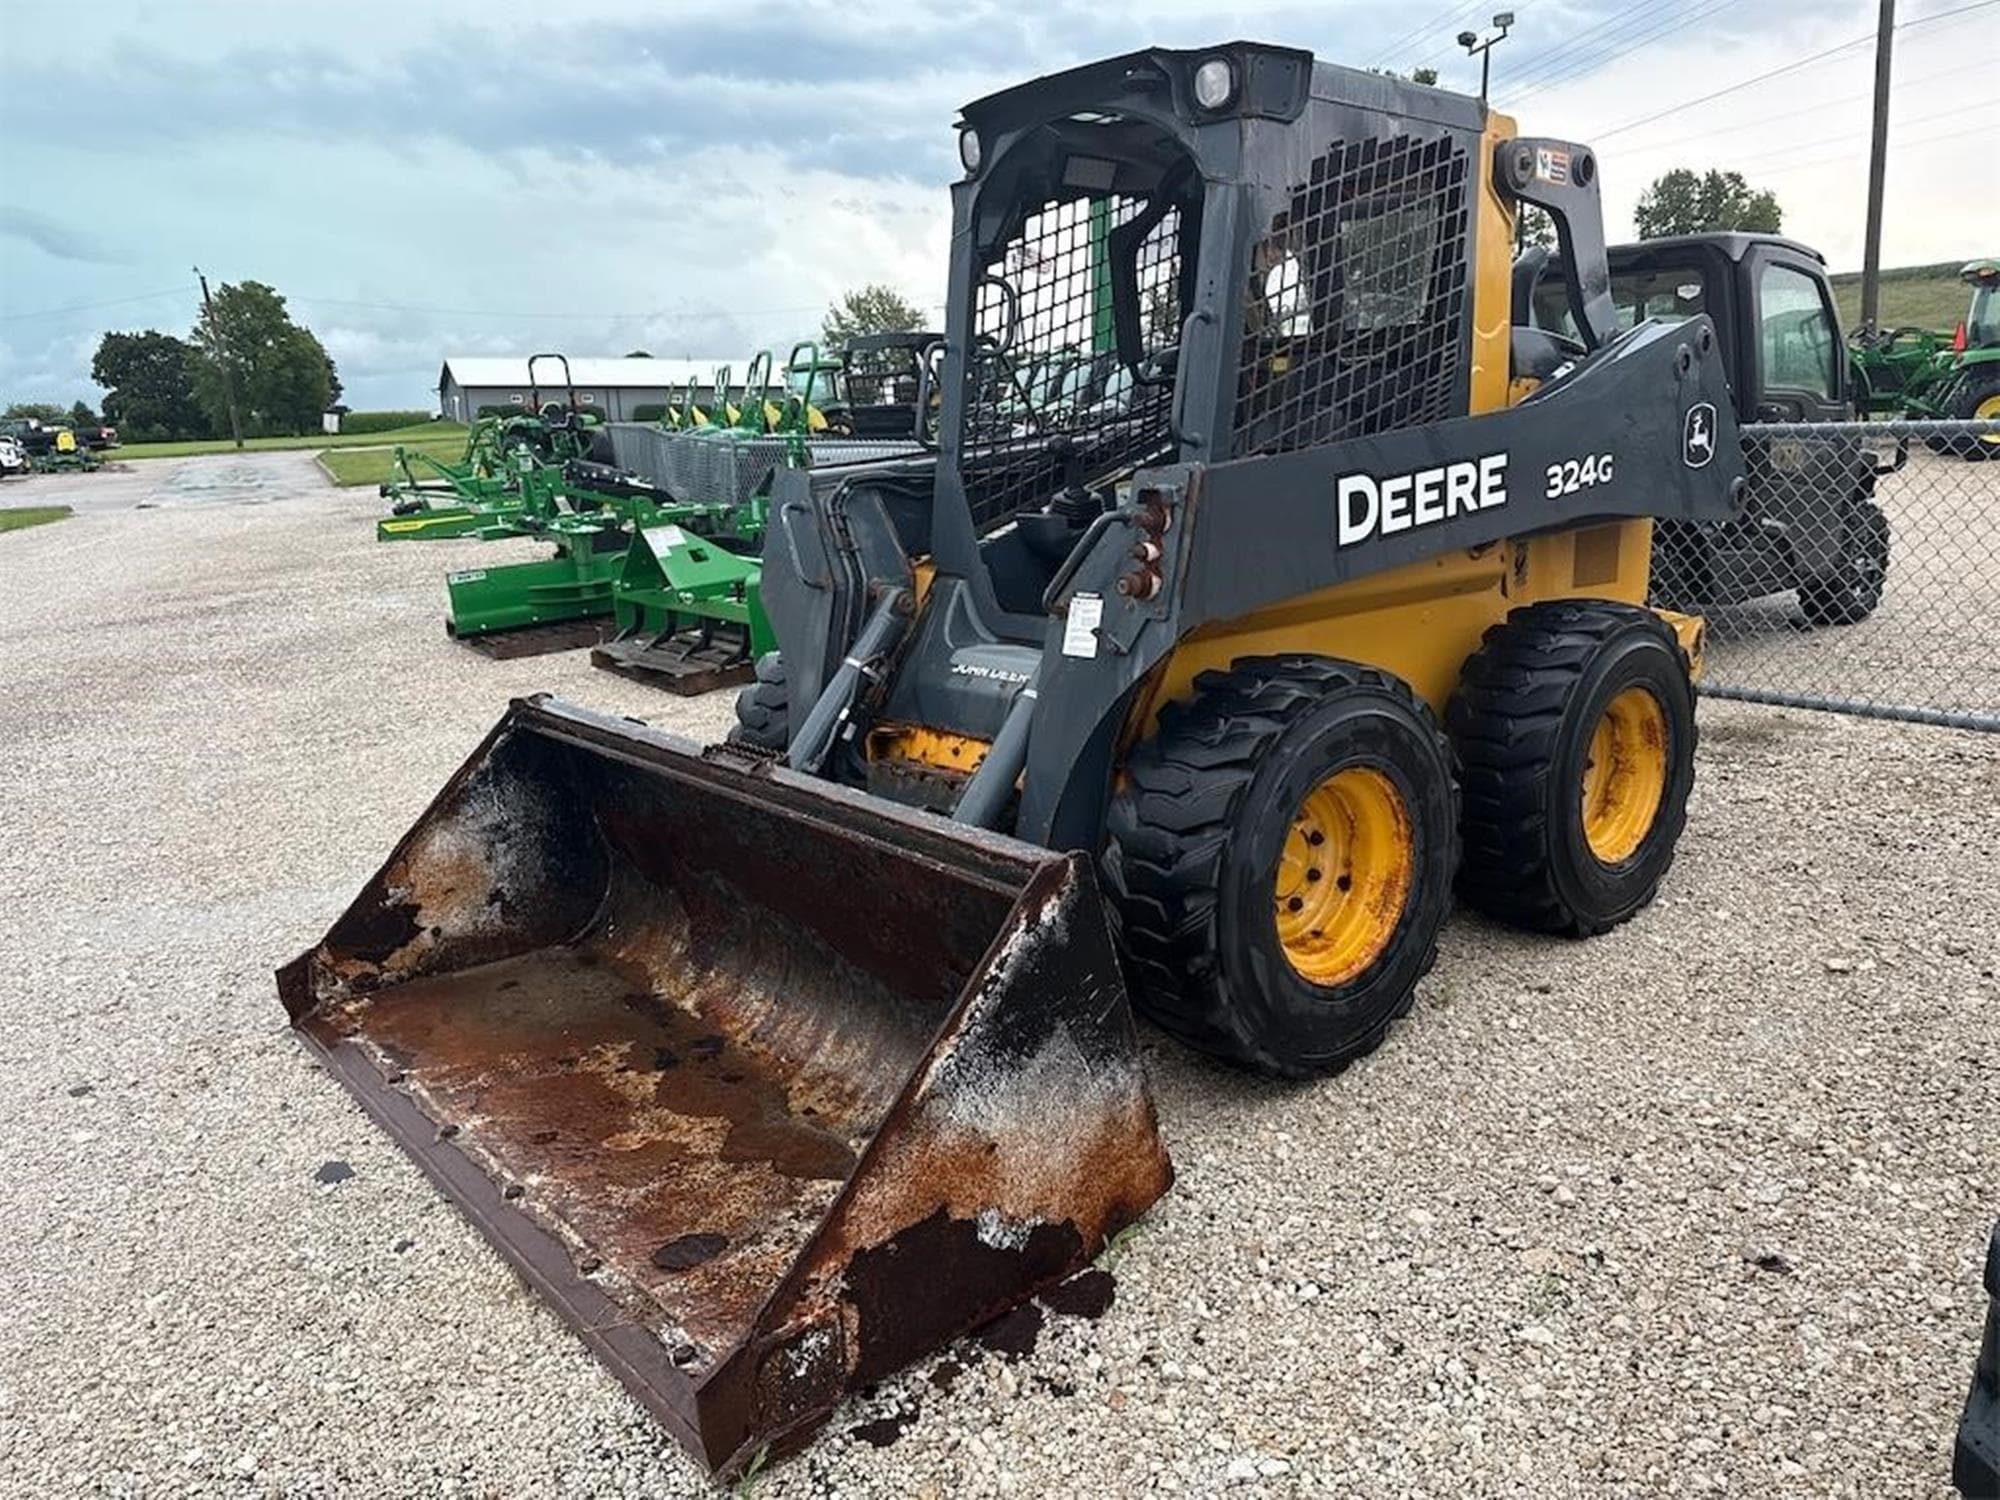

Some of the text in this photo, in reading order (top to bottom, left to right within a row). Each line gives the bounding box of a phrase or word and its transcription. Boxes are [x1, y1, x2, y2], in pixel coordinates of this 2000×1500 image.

[1545, 454, 1614, 499] 324G
[1337, 453, 1508, 546] DEERE
[988, 669, 1031, 683] DEER
